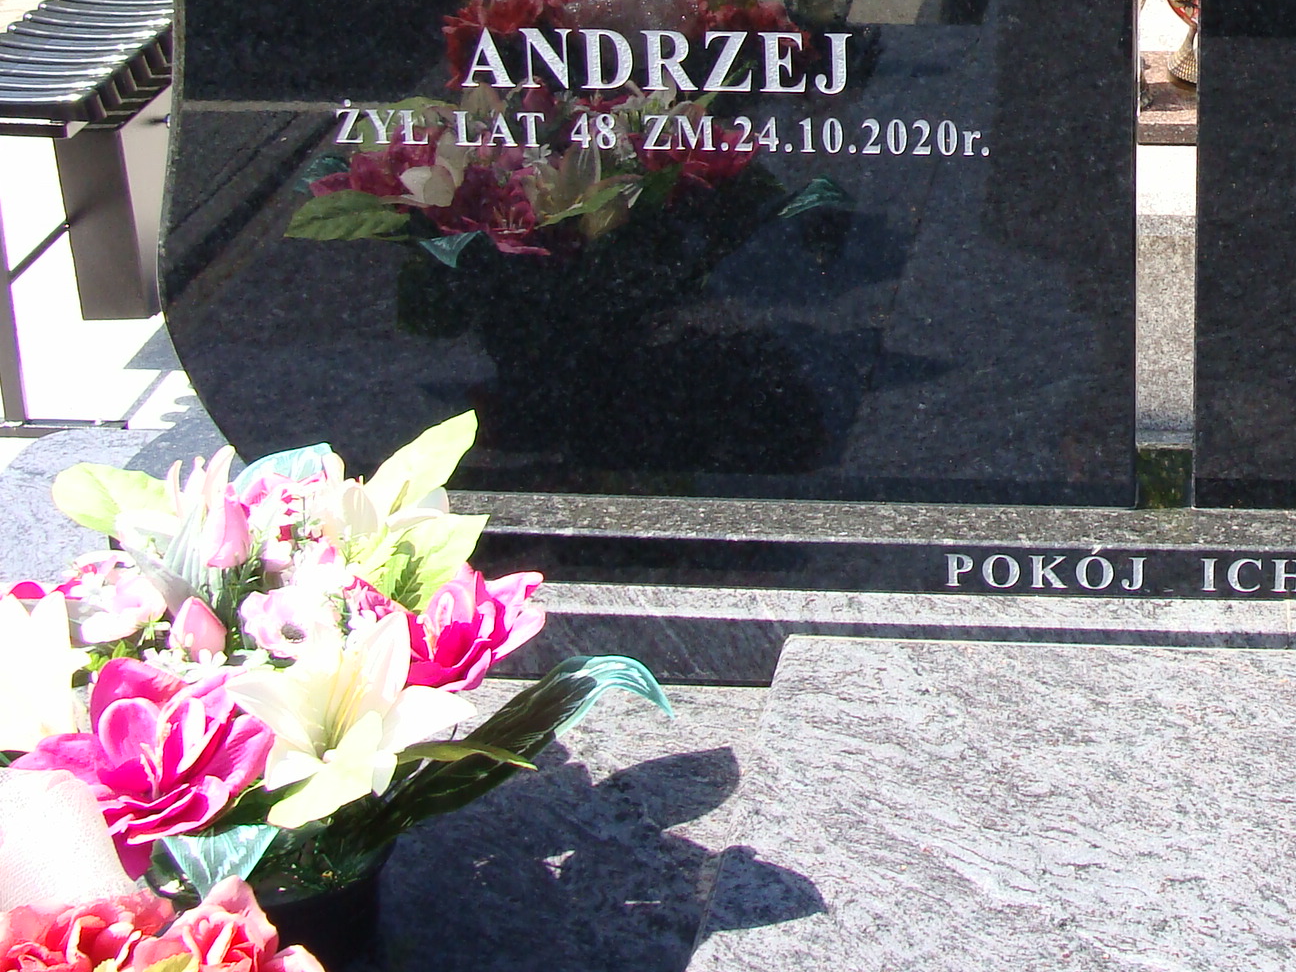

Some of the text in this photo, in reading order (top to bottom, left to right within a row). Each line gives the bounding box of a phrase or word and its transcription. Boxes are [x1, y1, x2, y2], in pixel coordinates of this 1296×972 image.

[462, 28, 852, 95] ANDRZEJ
[335, 99, 429, 146] ŻYŁ
[455, 112, 545, 148] LAT
[571, 113, 616, 151] 48
[944, 546, 1146, 591] POKÓJ
